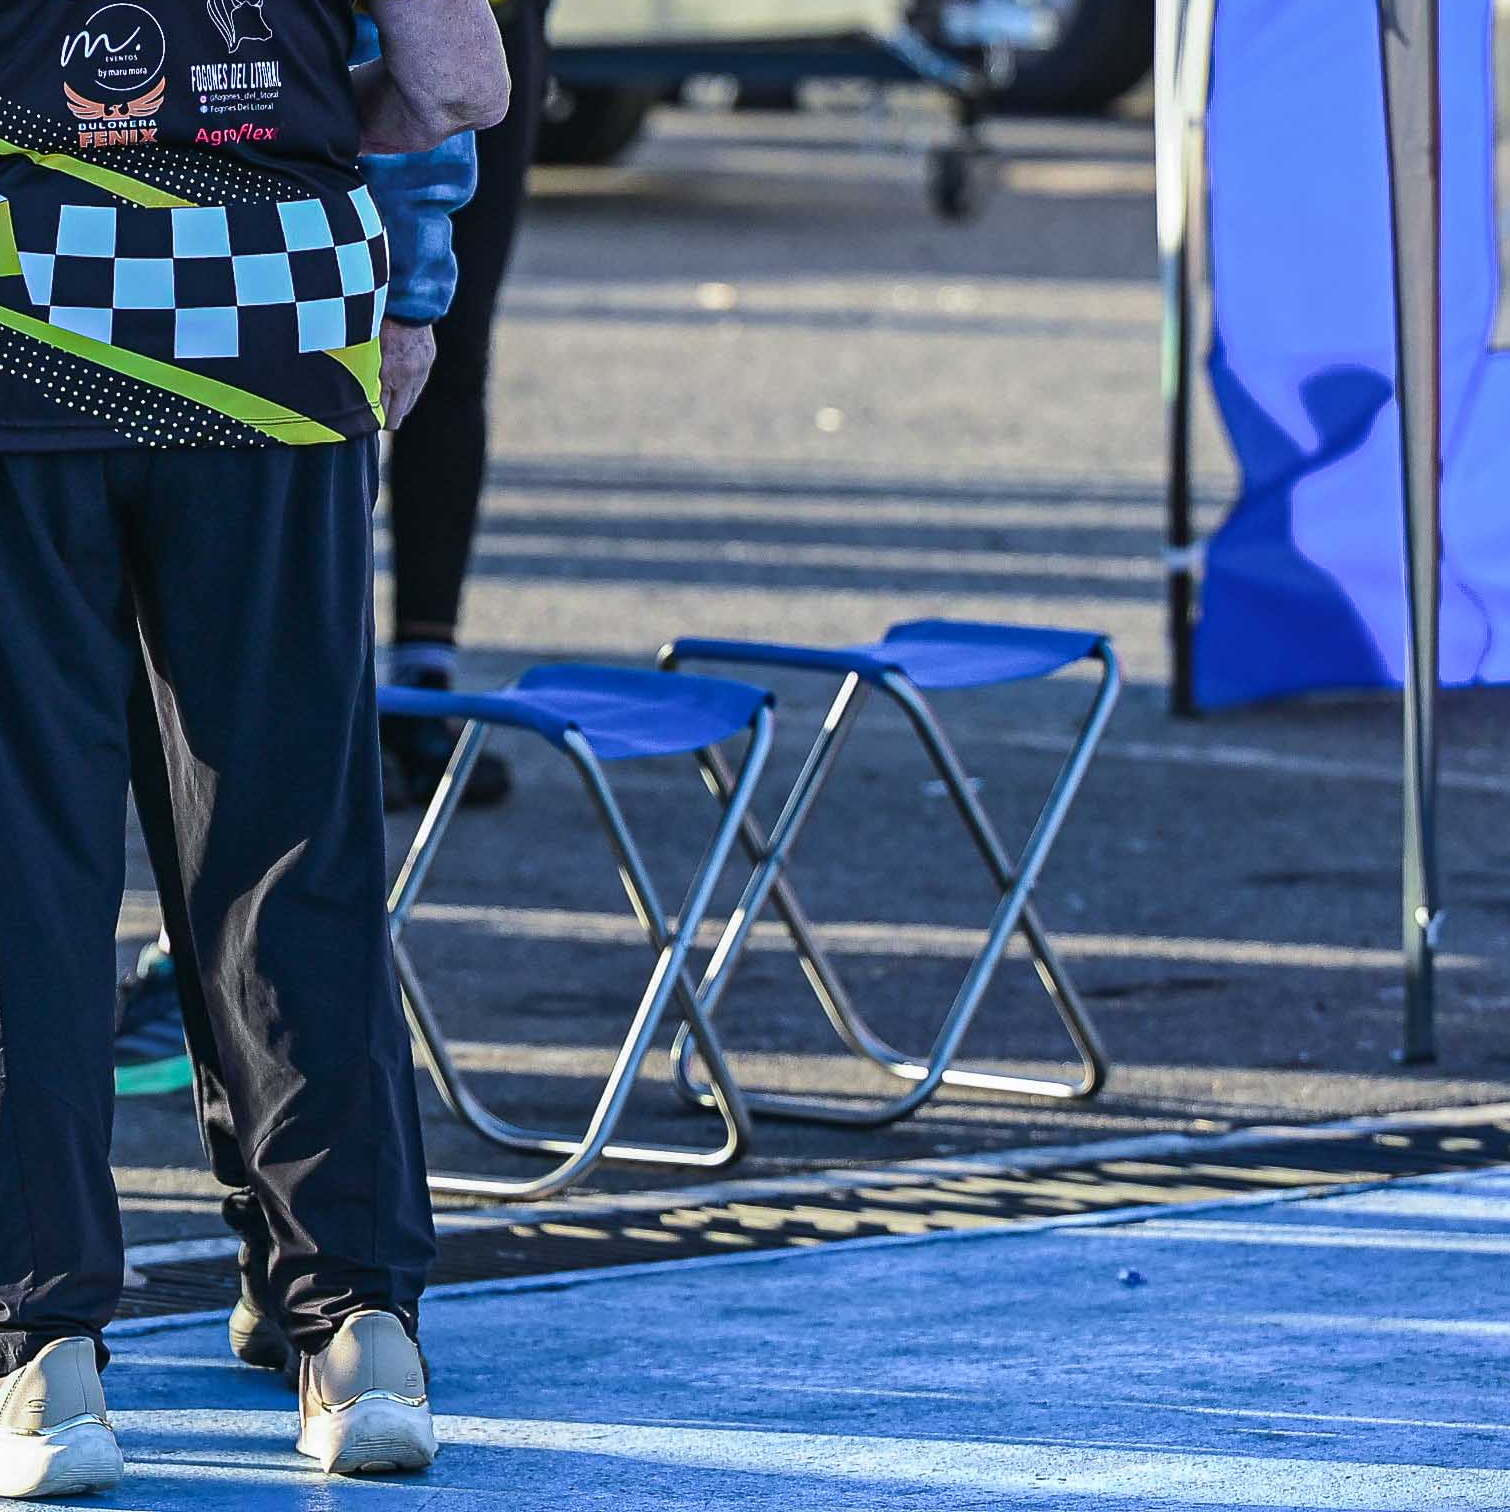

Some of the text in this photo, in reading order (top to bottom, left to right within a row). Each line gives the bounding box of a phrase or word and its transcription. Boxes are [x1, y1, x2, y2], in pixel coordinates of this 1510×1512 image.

[105, 53, 138, 63] EVENTOS
[97, 67, 148, 78] by maru mora
[190, 60, 282, 93] FOGONES DEL LITORAL
[77, 118, 157, 131] BULONERA
[77, 128, 158, 149] FENIX
[194, 122, 275, 146] Agroflex
